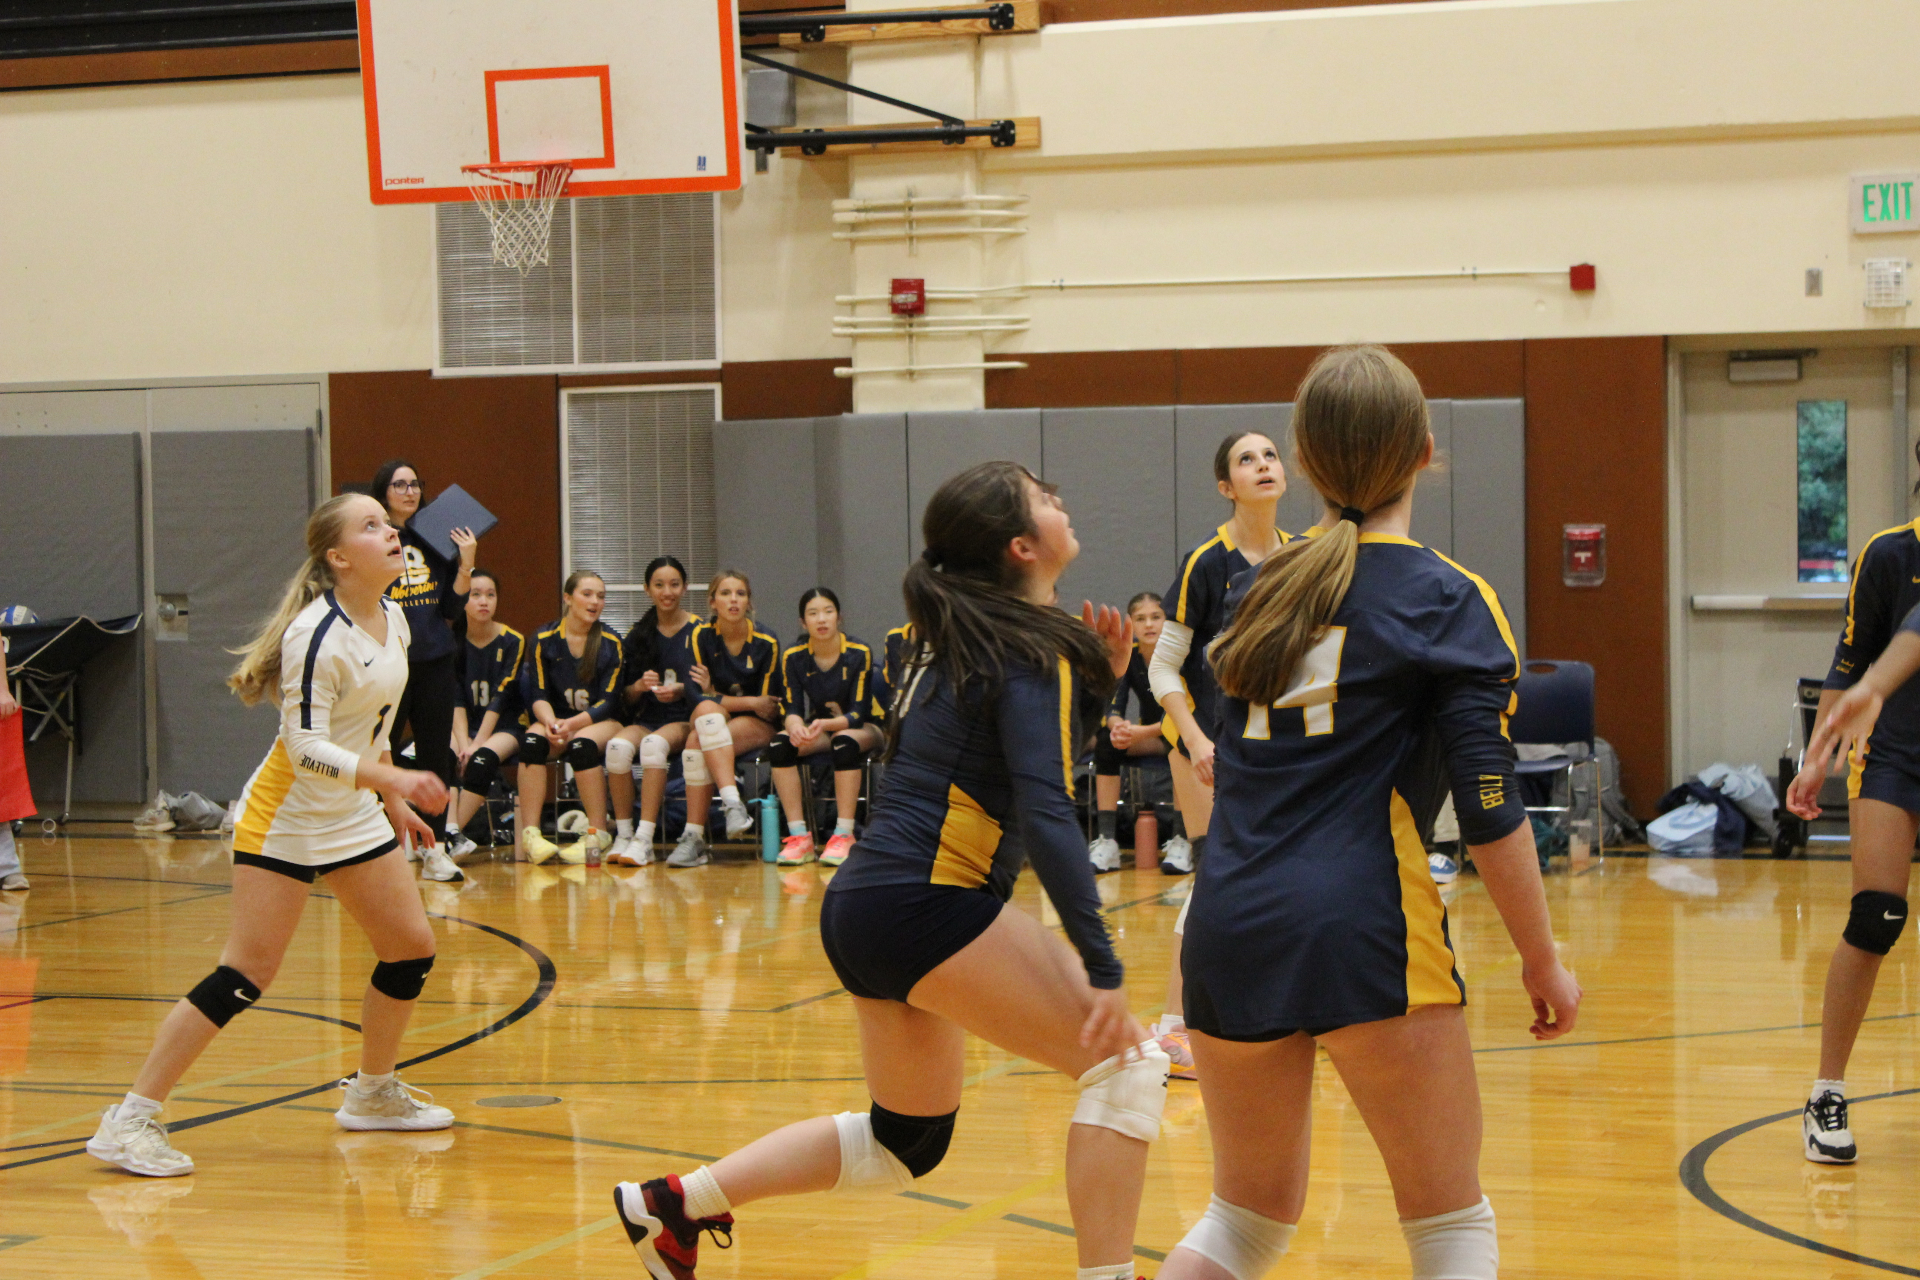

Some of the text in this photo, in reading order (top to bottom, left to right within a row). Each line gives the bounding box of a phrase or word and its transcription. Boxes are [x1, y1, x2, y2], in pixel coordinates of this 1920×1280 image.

[1863, 182, 1914, 222] EXIT
[471, 680, 490, 707] 13
[564, 688, 590, 711] 16
[299, 754, 340, 778] BELLEVUE
